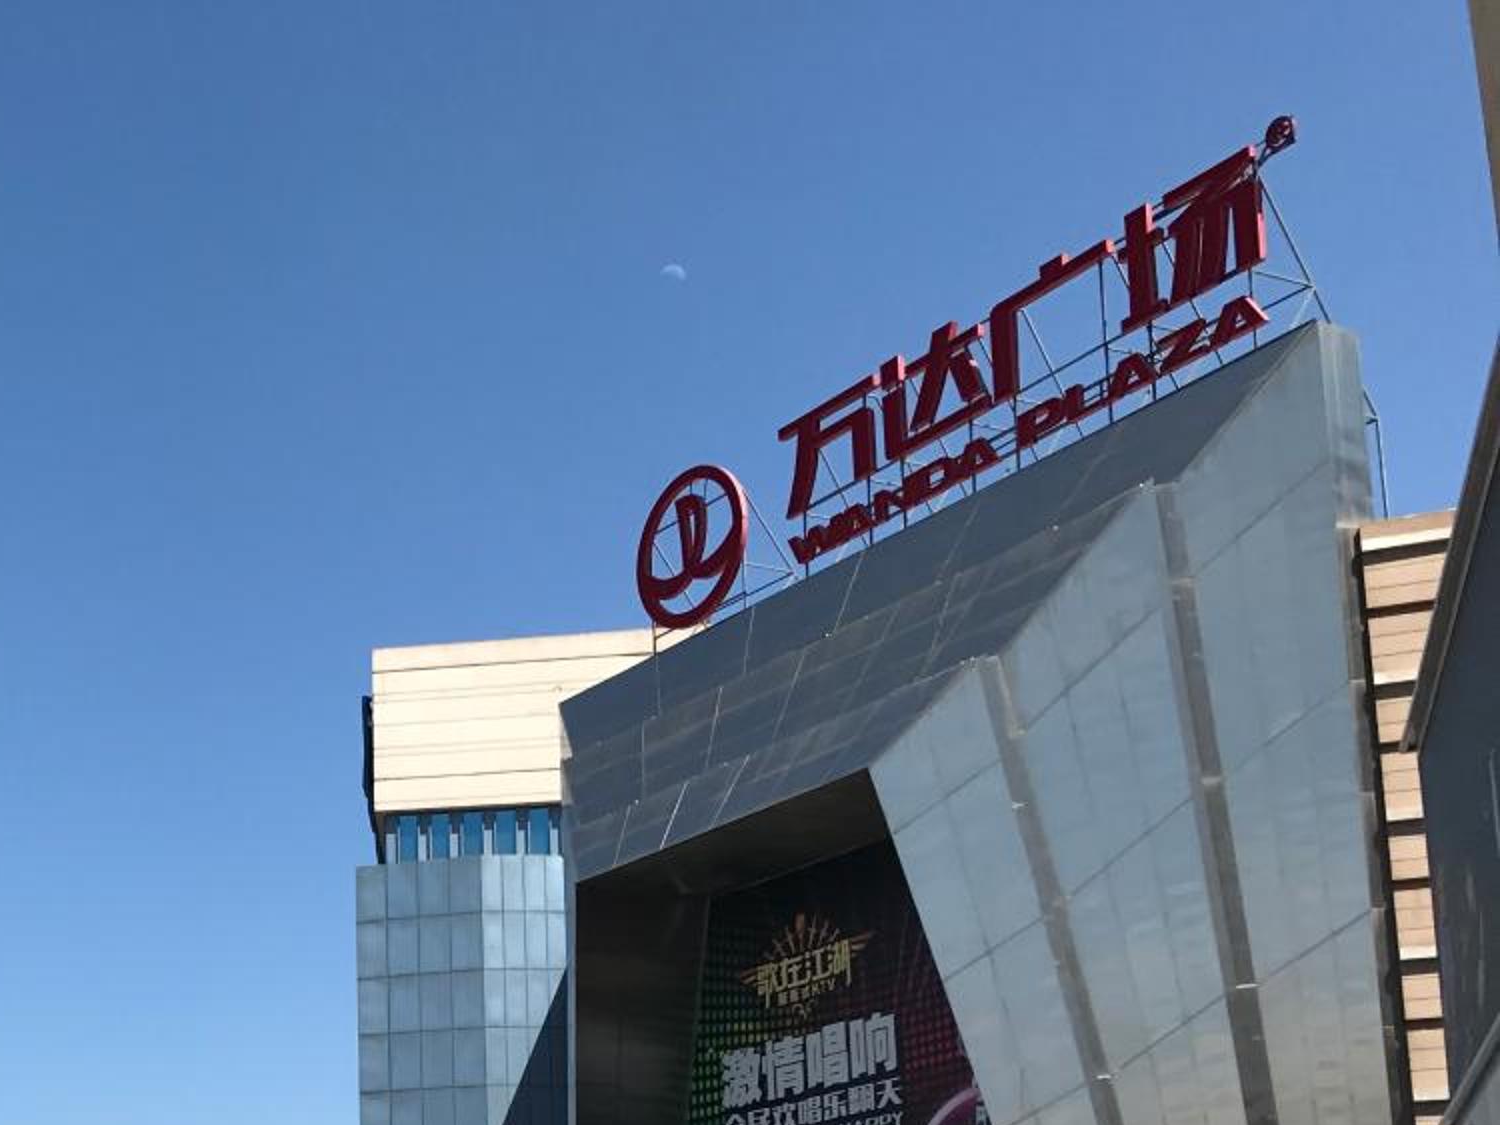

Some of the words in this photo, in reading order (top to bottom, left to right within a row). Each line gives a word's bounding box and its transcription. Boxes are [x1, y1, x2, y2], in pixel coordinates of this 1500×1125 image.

[778, 145, 1268, 519] 万达广场
[788, 436, 1001, 566] WANDA
[1016, 295, 1270, 450] PLAZA
[722, 1012, 898, 1109] 激情唱响
